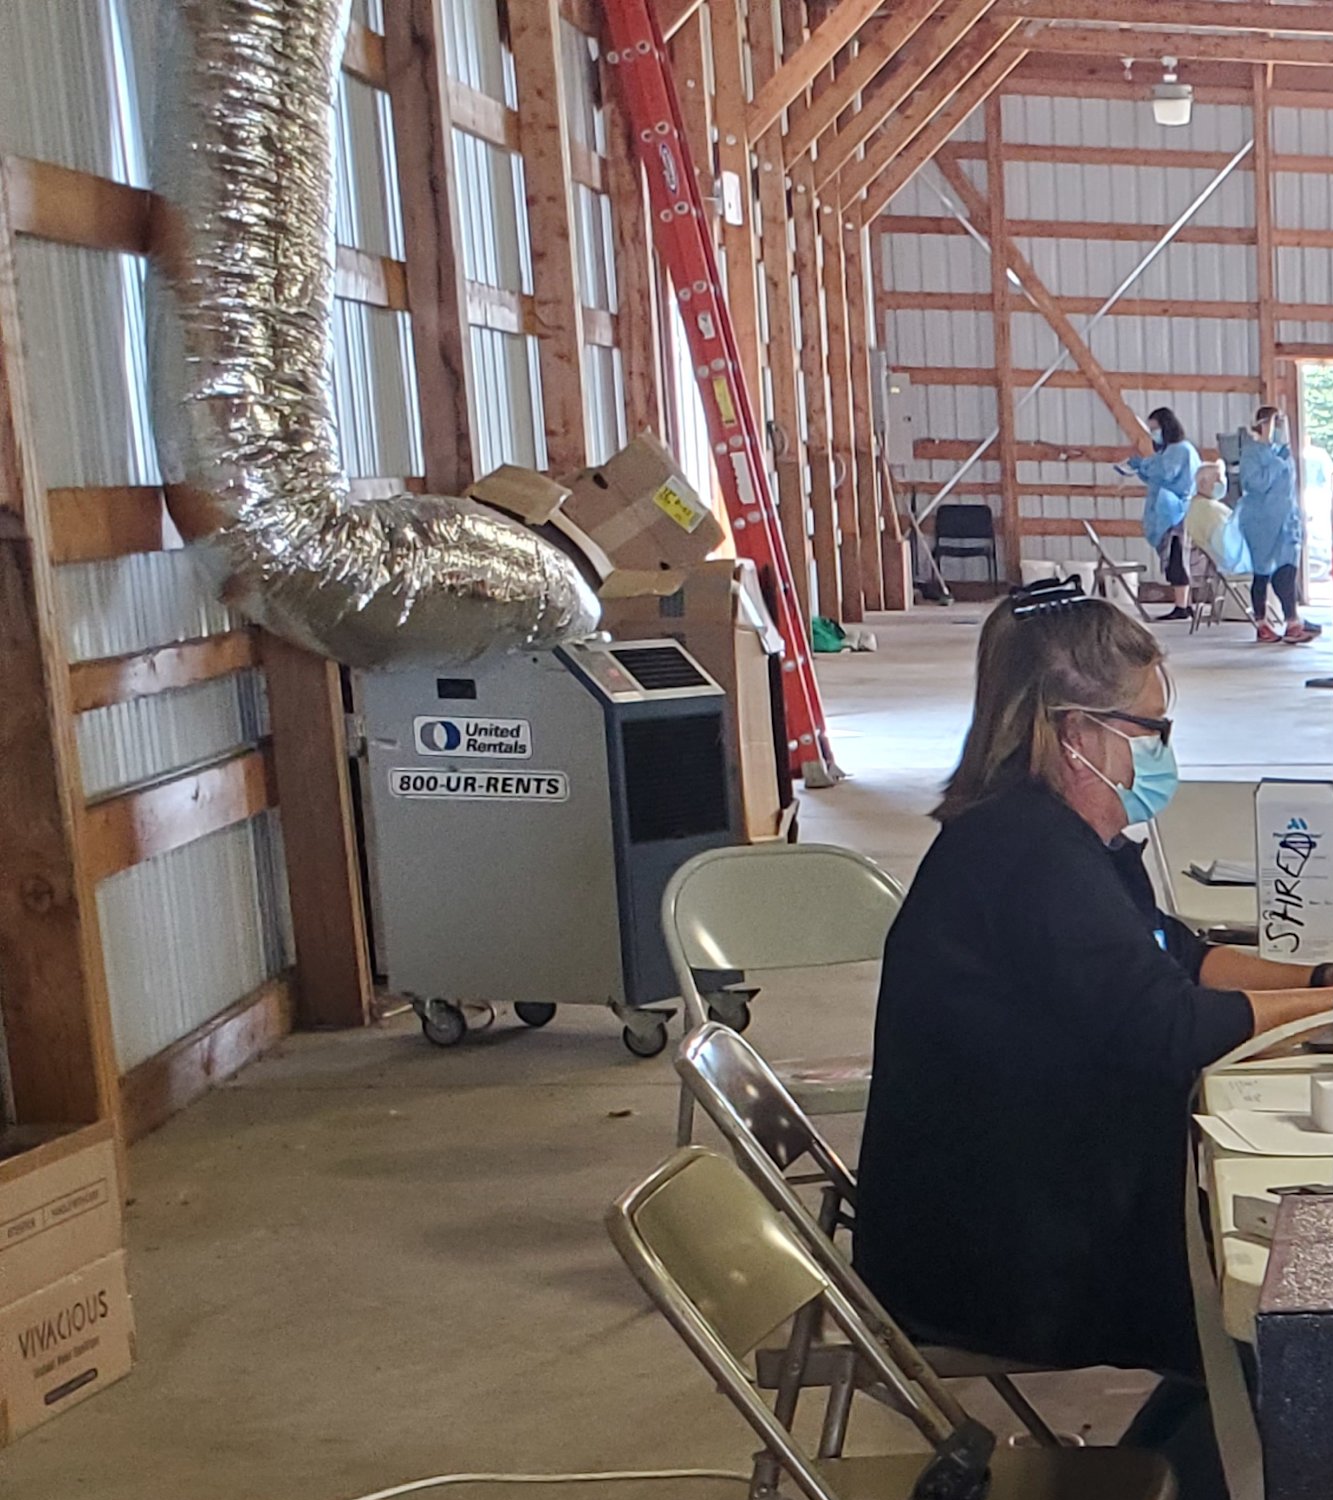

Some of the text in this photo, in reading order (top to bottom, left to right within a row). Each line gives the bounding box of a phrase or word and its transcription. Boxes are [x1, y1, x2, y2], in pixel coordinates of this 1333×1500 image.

[465, 722, 521, 738] United
[466, 739, 527, 754] Rentals
[399, 775, 560, 794] 800-UR-RENTS
[19, 1290, 109, 1359] VIVACIOUS
